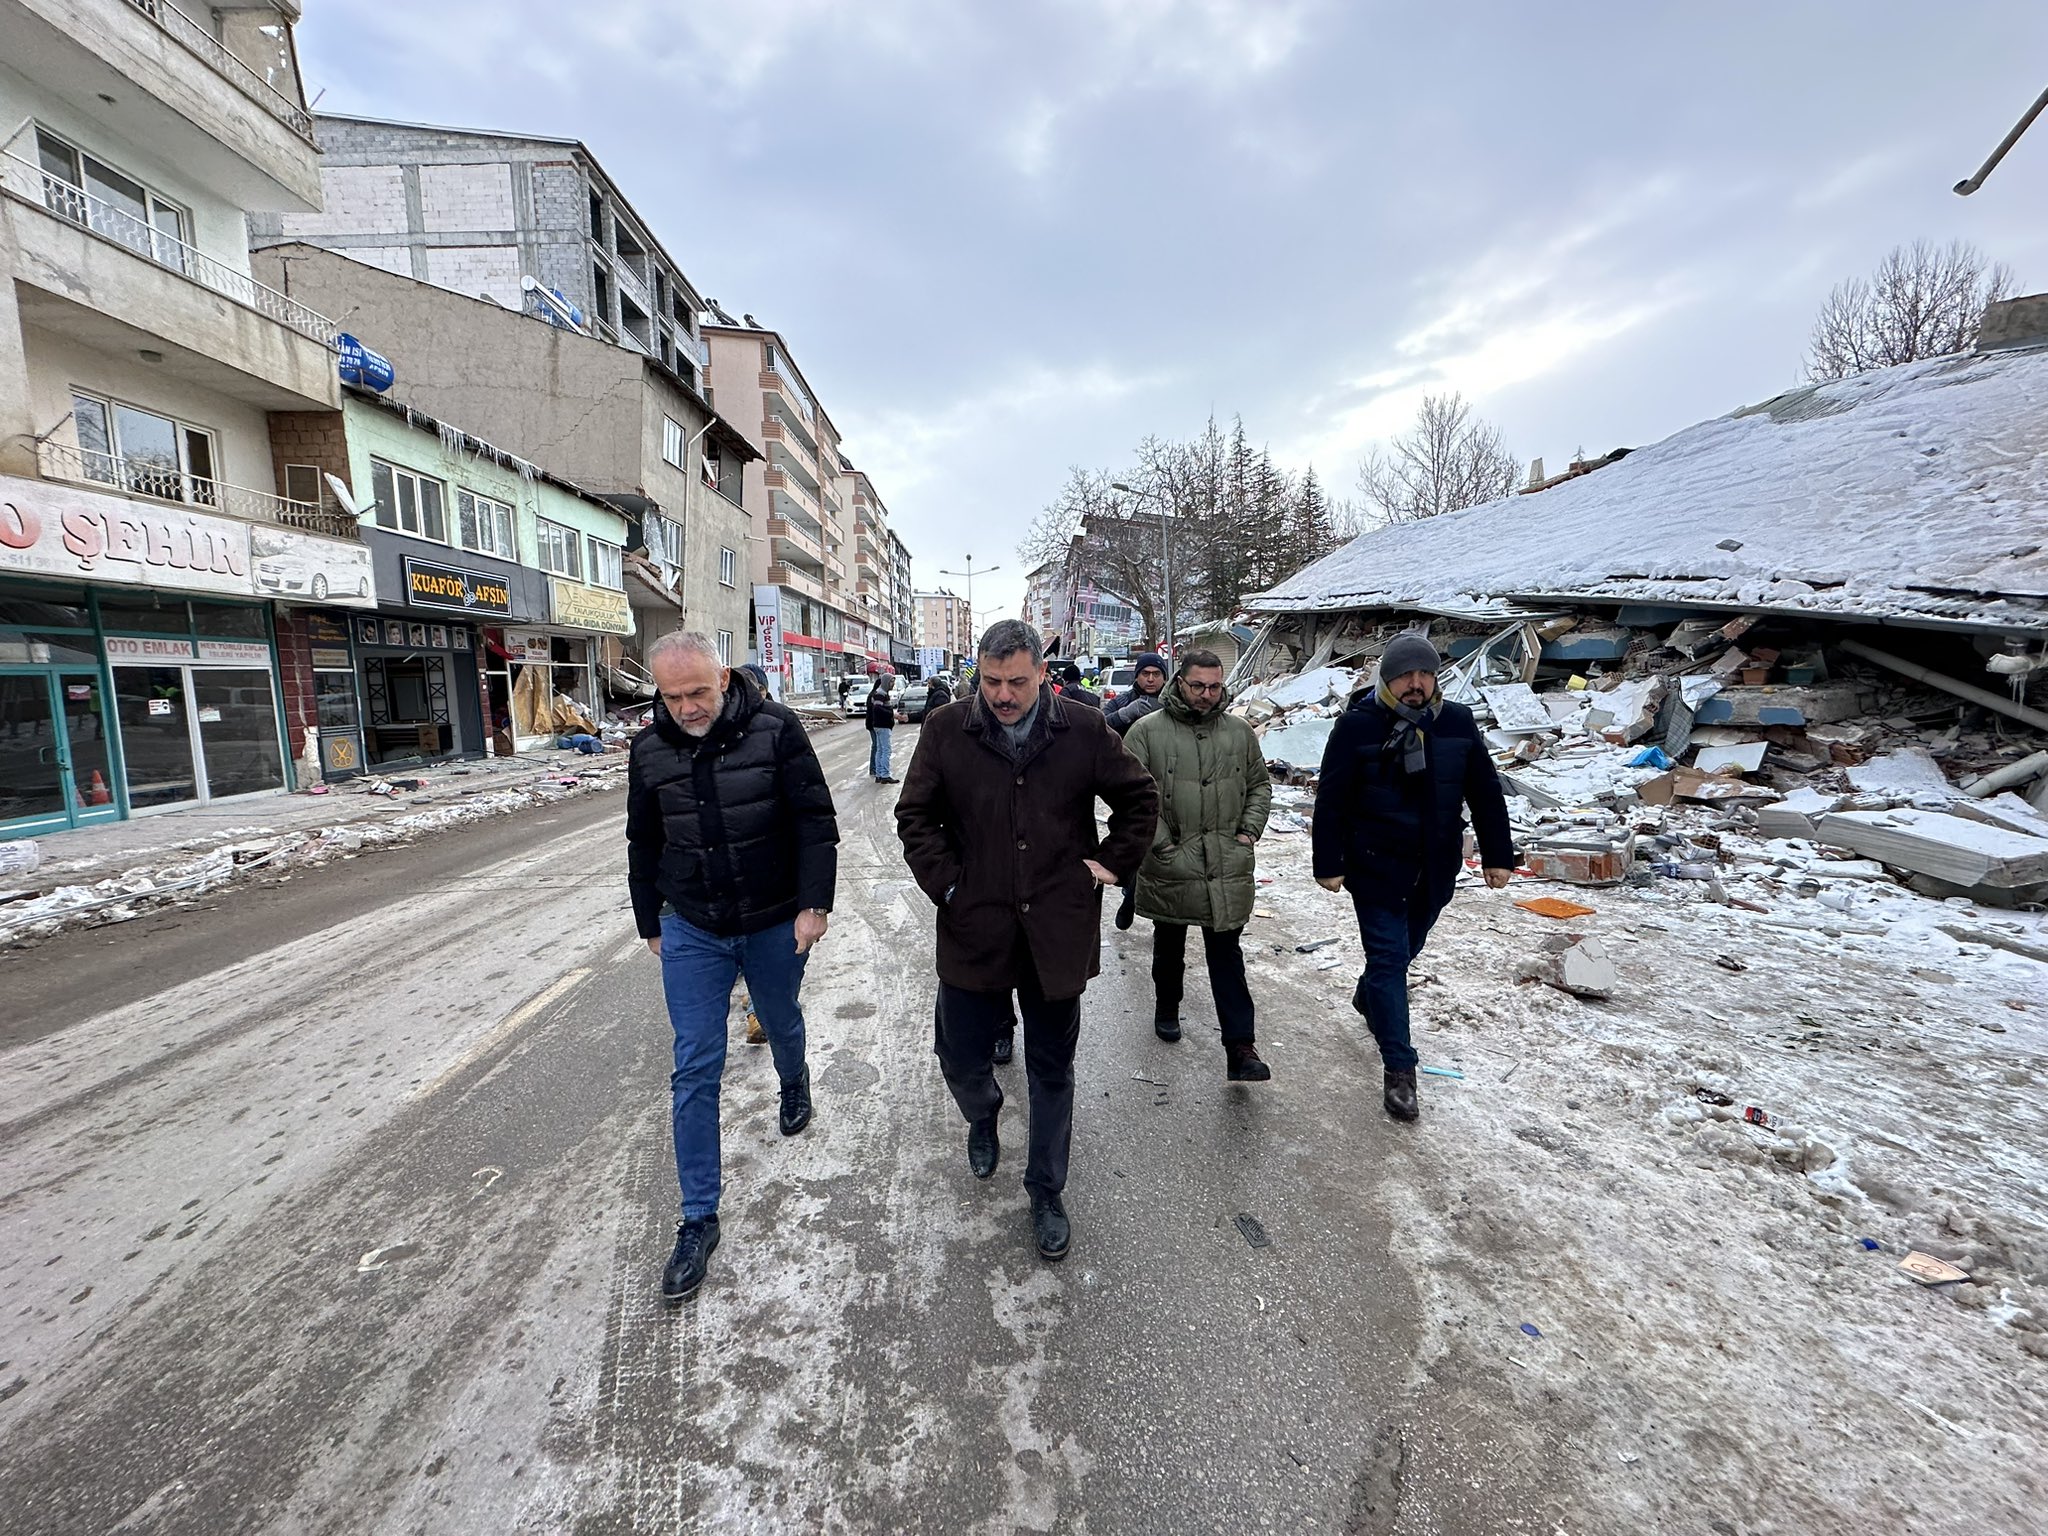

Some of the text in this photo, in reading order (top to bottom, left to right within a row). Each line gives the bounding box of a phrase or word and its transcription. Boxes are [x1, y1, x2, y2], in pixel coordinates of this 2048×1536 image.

[61, 507, 244, 577] ŞEHİR
[411, 573, 508, 607] KUAFÖR AFŞİN
[558, 614, 628, 633] HELAL GIDA DÜNYASI
[106, 638, 191, 656] OTO EMLAK
[200, 642, 216, 650] HER
[243, 644, 268, 652] EMLAK
[763, 628, 773, 662] GROSS
